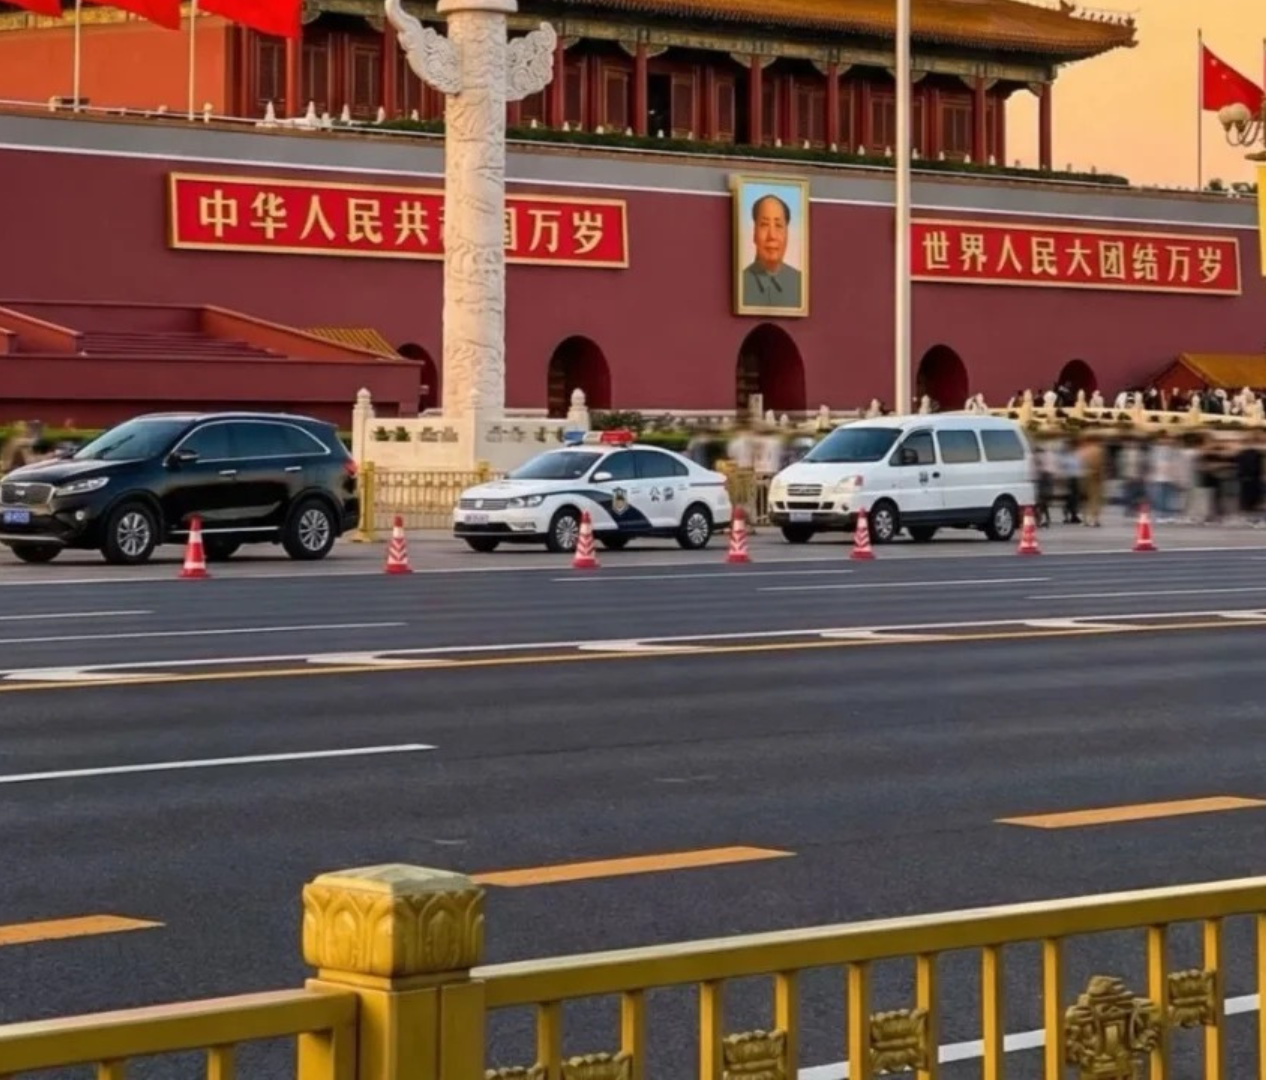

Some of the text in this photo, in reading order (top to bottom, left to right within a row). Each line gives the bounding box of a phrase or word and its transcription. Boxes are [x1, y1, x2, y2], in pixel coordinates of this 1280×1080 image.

[199, 189, 604, 255] 中华人民共万岁
[922, 231, 1223, 283] 世界人民大团结万岁
